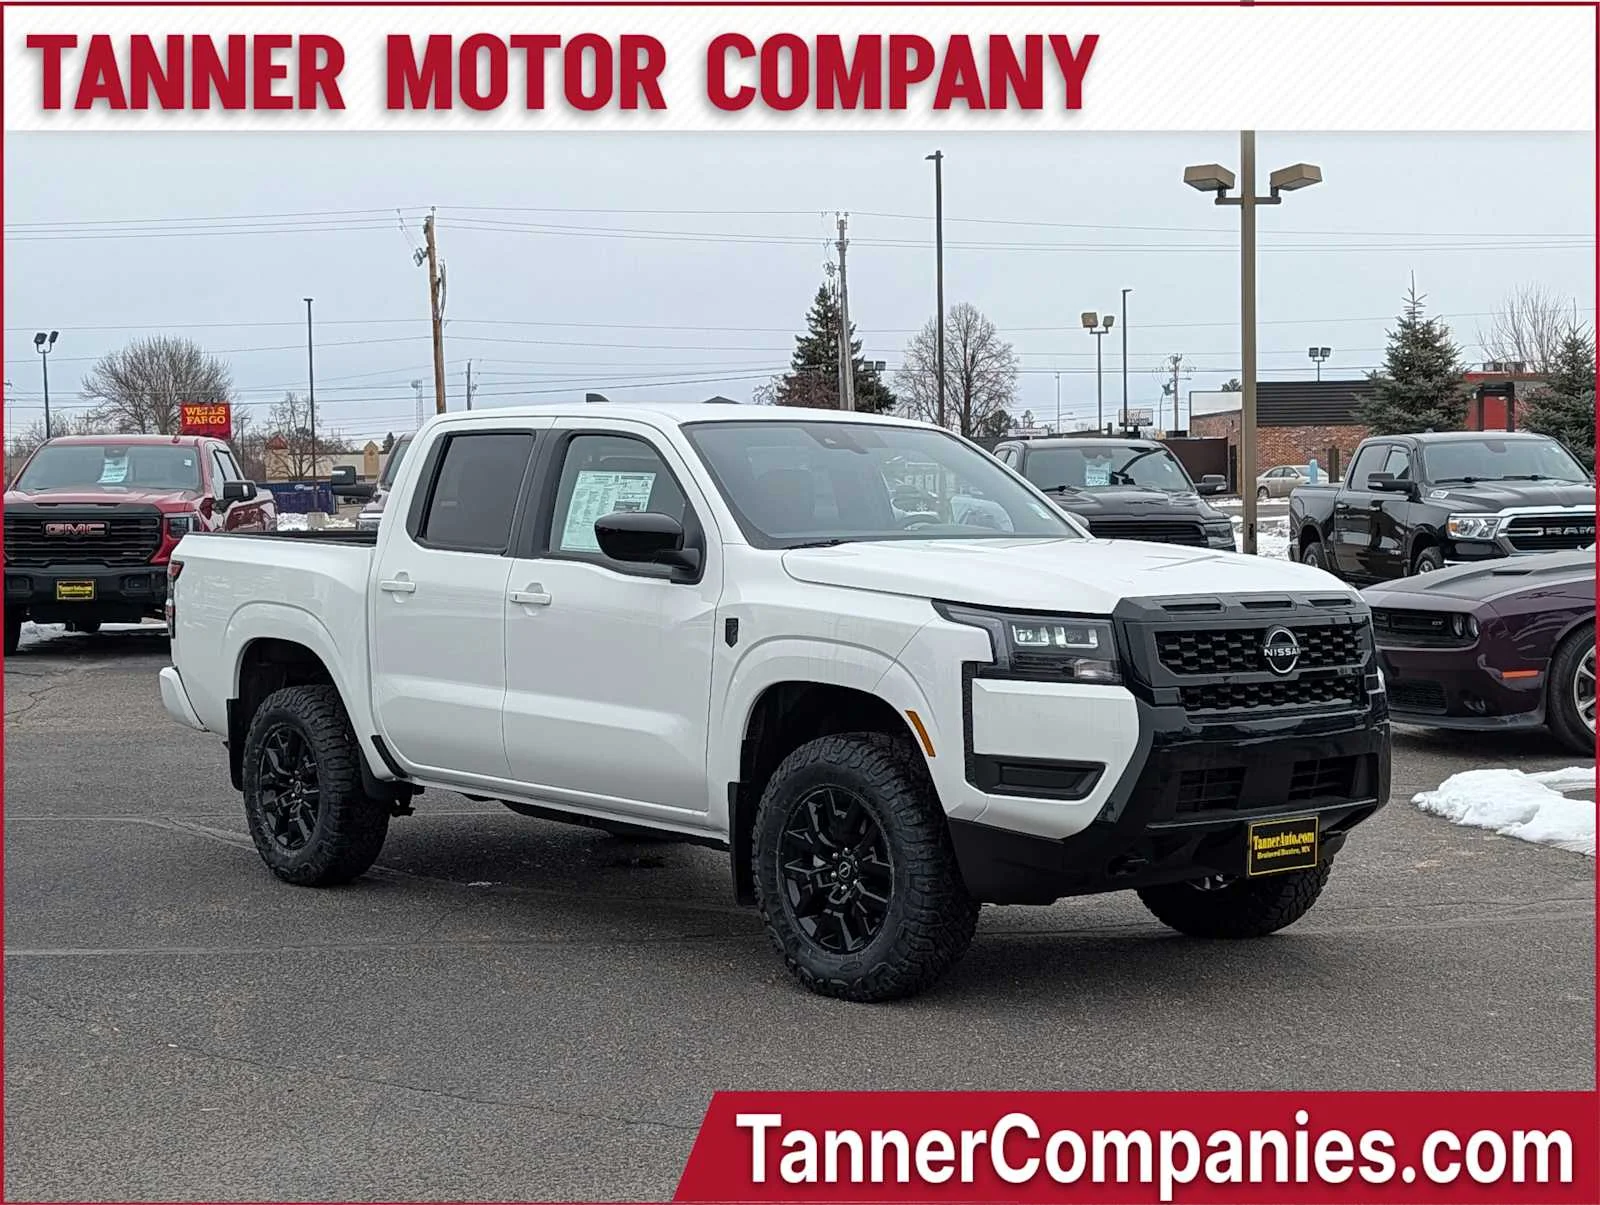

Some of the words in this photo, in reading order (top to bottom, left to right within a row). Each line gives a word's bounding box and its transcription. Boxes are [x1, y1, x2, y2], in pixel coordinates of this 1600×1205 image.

[184, 406, 226, 415] WELLS
[186, 415, 226, 425] FARGO
[45, 523, 105, 535] GMC
[1263, 647, 1302, 657] NISSAN
